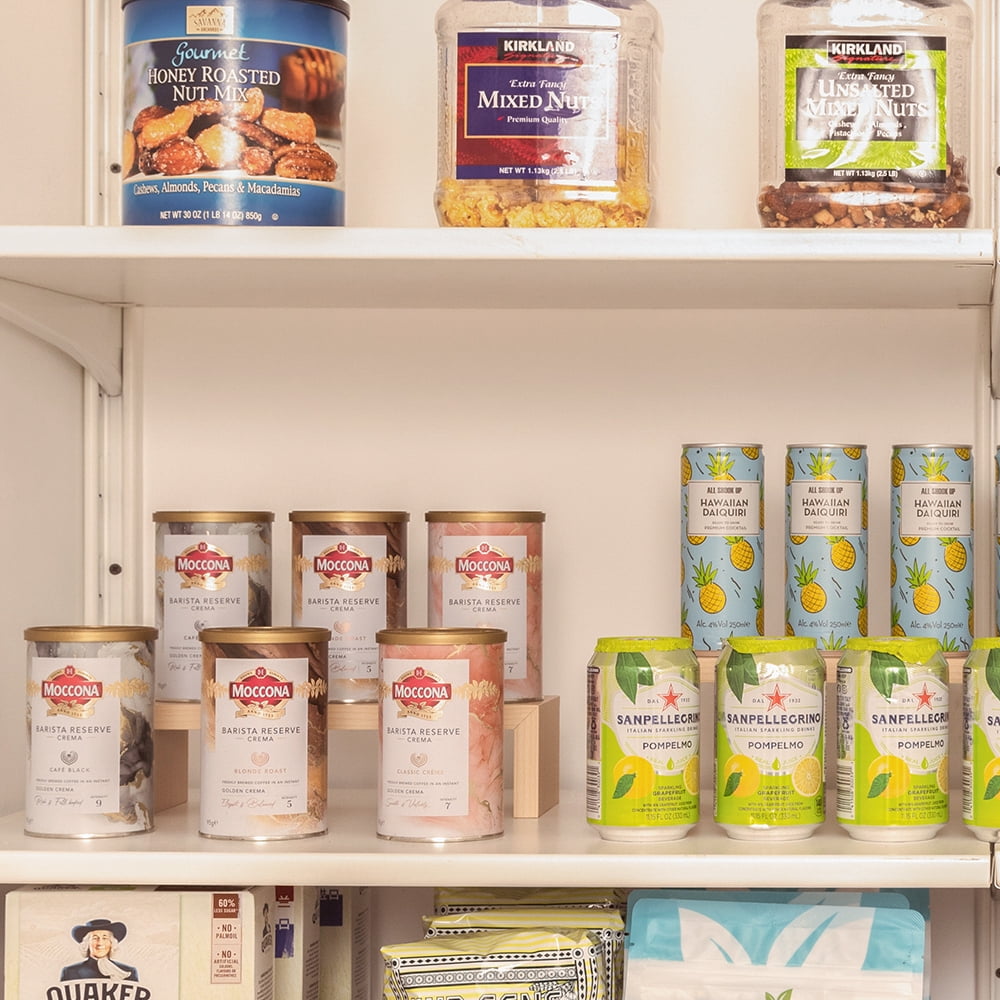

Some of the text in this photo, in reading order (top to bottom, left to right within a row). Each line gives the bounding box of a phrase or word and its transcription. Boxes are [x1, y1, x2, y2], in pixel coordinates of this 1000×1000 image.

[503, 40, 575, 52] KIRKLAND
[832, 43, 903, 55] KIRKLAND
[172, 42, 250, 67] Gourmet
[148, 66, 281, 86] HONEY ROASTED
[509, 80, 567, 90] Extra Fancy
[173, 84, 249, 102] NUT MIX
[477, 90, 596, 110] MIXED NUT
[875, 99, 928, 117] NUTS
[507, 116, 540, 124] Premium
[203, 181, 234, 193] Pecans
[236, 182, 245, 193] &
[247, 183, 301, 197] Macadamias
[245, 211, 263, 221] 850g
[700, 499, 749, 508] HAWAIIAN
[802, 498, 850, 508] HAWAIIAN
[914, 499, 962, 508] HAWAIIAN
[702, 508, 747, 518] DAIQUIRI
[804, 508, 848, 517] DAIQUIRI
[916, 509, 960, 518] DAIQUIRI
[177, 558, 231, 571] MOCCONA
[458, 559, 511, 572] MOCCONA
[169, 597, 241, 605] BARISTA RESERVE
[449, 598, 521, 606] BARISTA RESERVE
[44, 683, 100, 697] MOCCONA
[232, 683, 291, 698] MOCCONA
[394, 683, 449, 699] MOCCONA
[727, 712, 821, 725] SANPELLEGRINO
[36, 725, 112, 734] BARISTA RESERVE
[221, 726, 301, 735] BARISTA RESERVE
[387, 727, 460, 736] BARISTA RESERVE
[642, 740, 692, 751] POMPELMO
[748, 741, 804, 750] POMPELMO
[286, 800, 293, 808] 5
[218, 898, 235, 907] 60%
[222, 924, 231, 932] NO
[222, 950, 231, 958] NO
